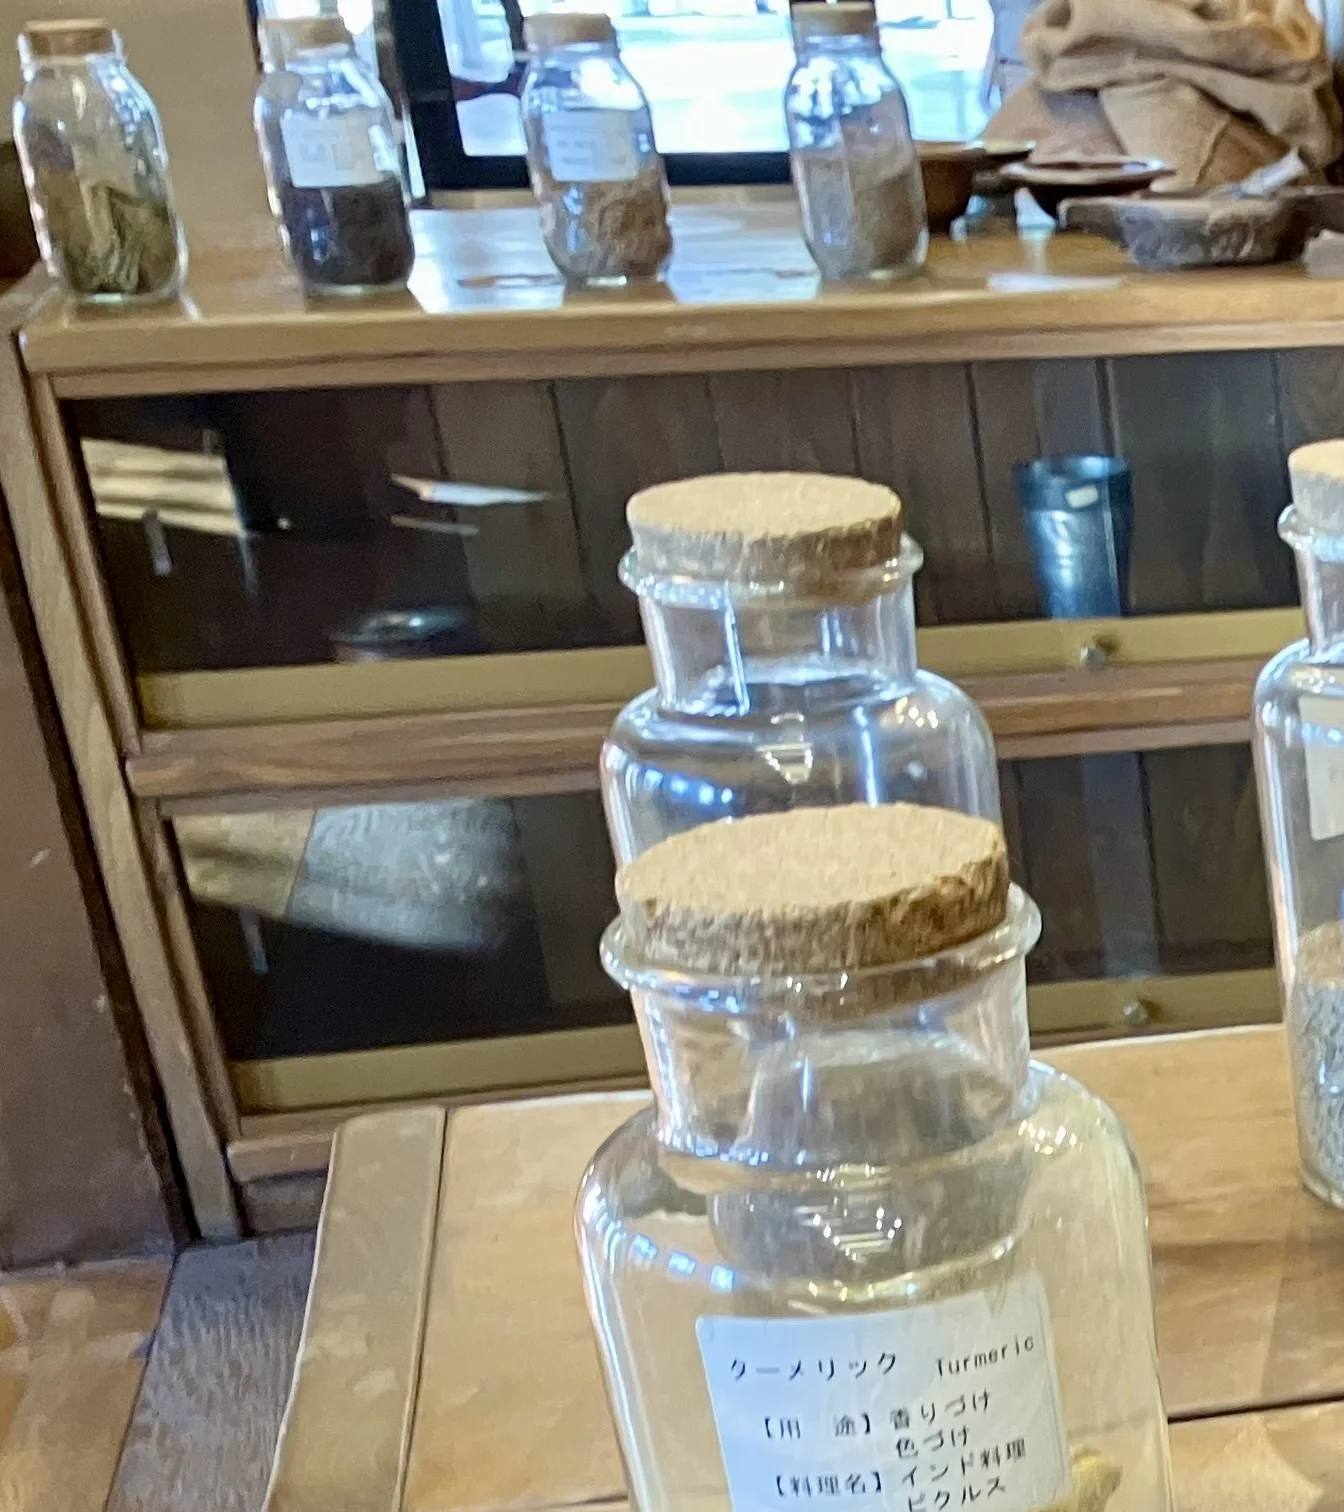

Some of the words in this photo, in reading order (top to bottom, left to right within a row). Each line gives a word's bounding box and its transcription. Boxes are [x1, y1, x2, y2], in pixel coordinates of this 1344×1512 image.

[731, 1352, 896, 1381] ターメリック
[936, 1335, 1034, 1378] Turmeric
[897, 1425, 969, 1459] 色づけ
